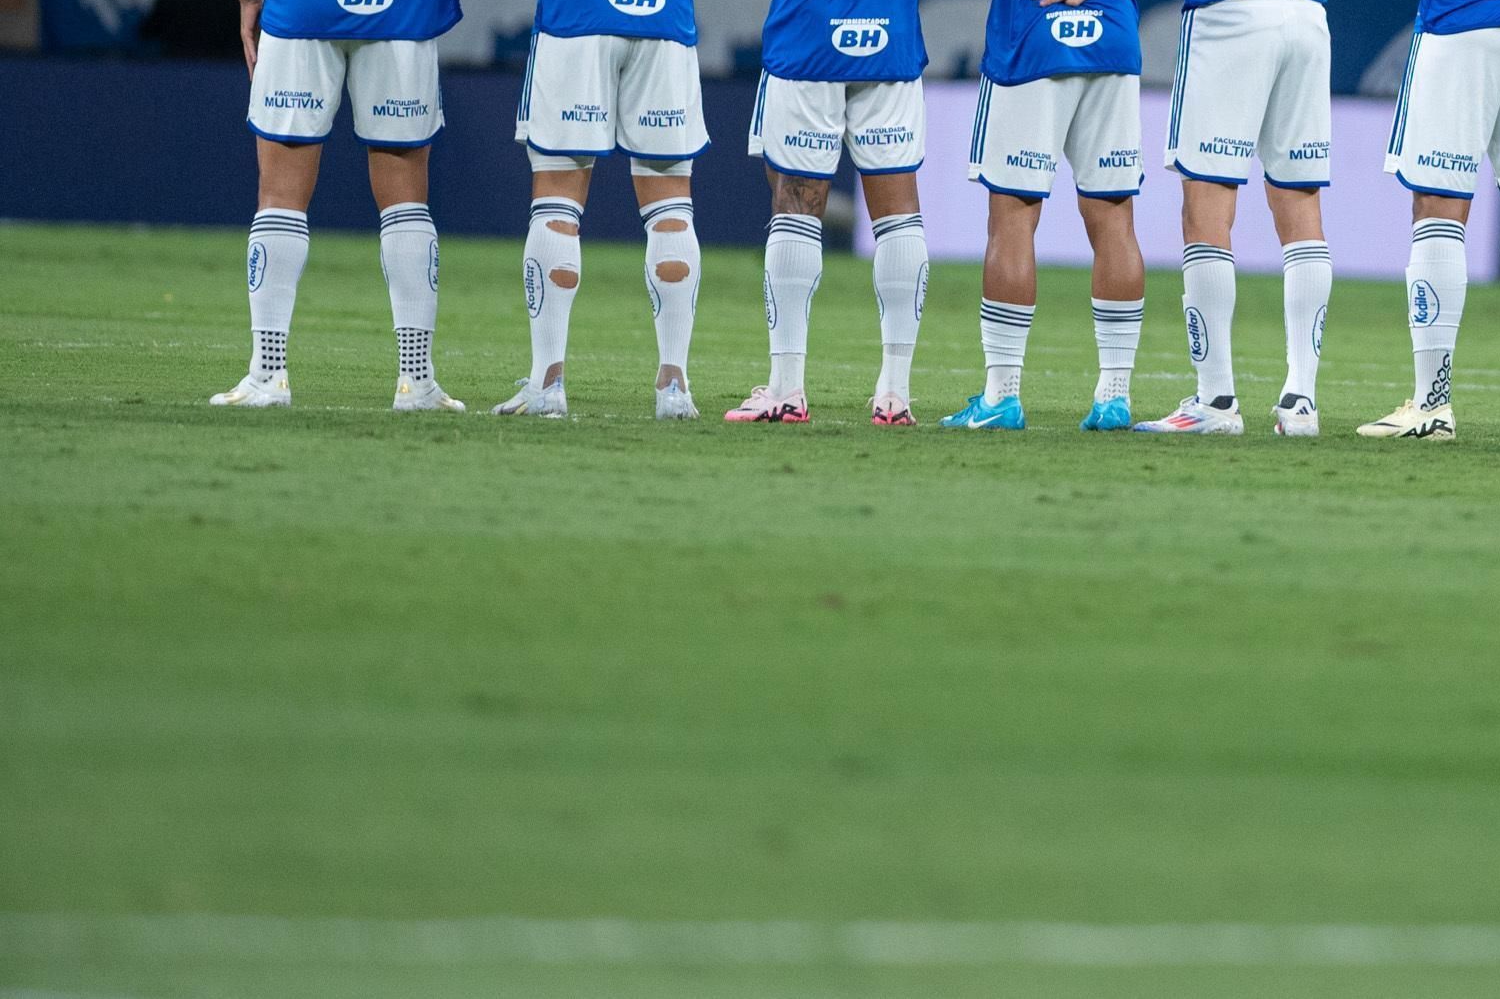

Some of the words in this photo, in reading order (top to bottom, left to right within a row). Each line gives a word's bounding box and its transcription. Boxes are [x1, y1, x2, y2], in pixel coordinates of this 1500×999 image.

[1058, 21, 1096, 39] BH
[838, 30, 881, 48] BH
[264, 97, 324, 110] MULTIVIX
[372, 104, 428, 118] MULTIVIX
[855, 131, 914, 146] MULTIVIX
[1099, 155, 1137, 168] MULT
[1289, 148, 1330, 161] MULT
[526, 263, 537, 311] Kodilar
[1414, 284, 1427, 325] Kodilar
[1188, 311, 1202, 356] Kodilar
